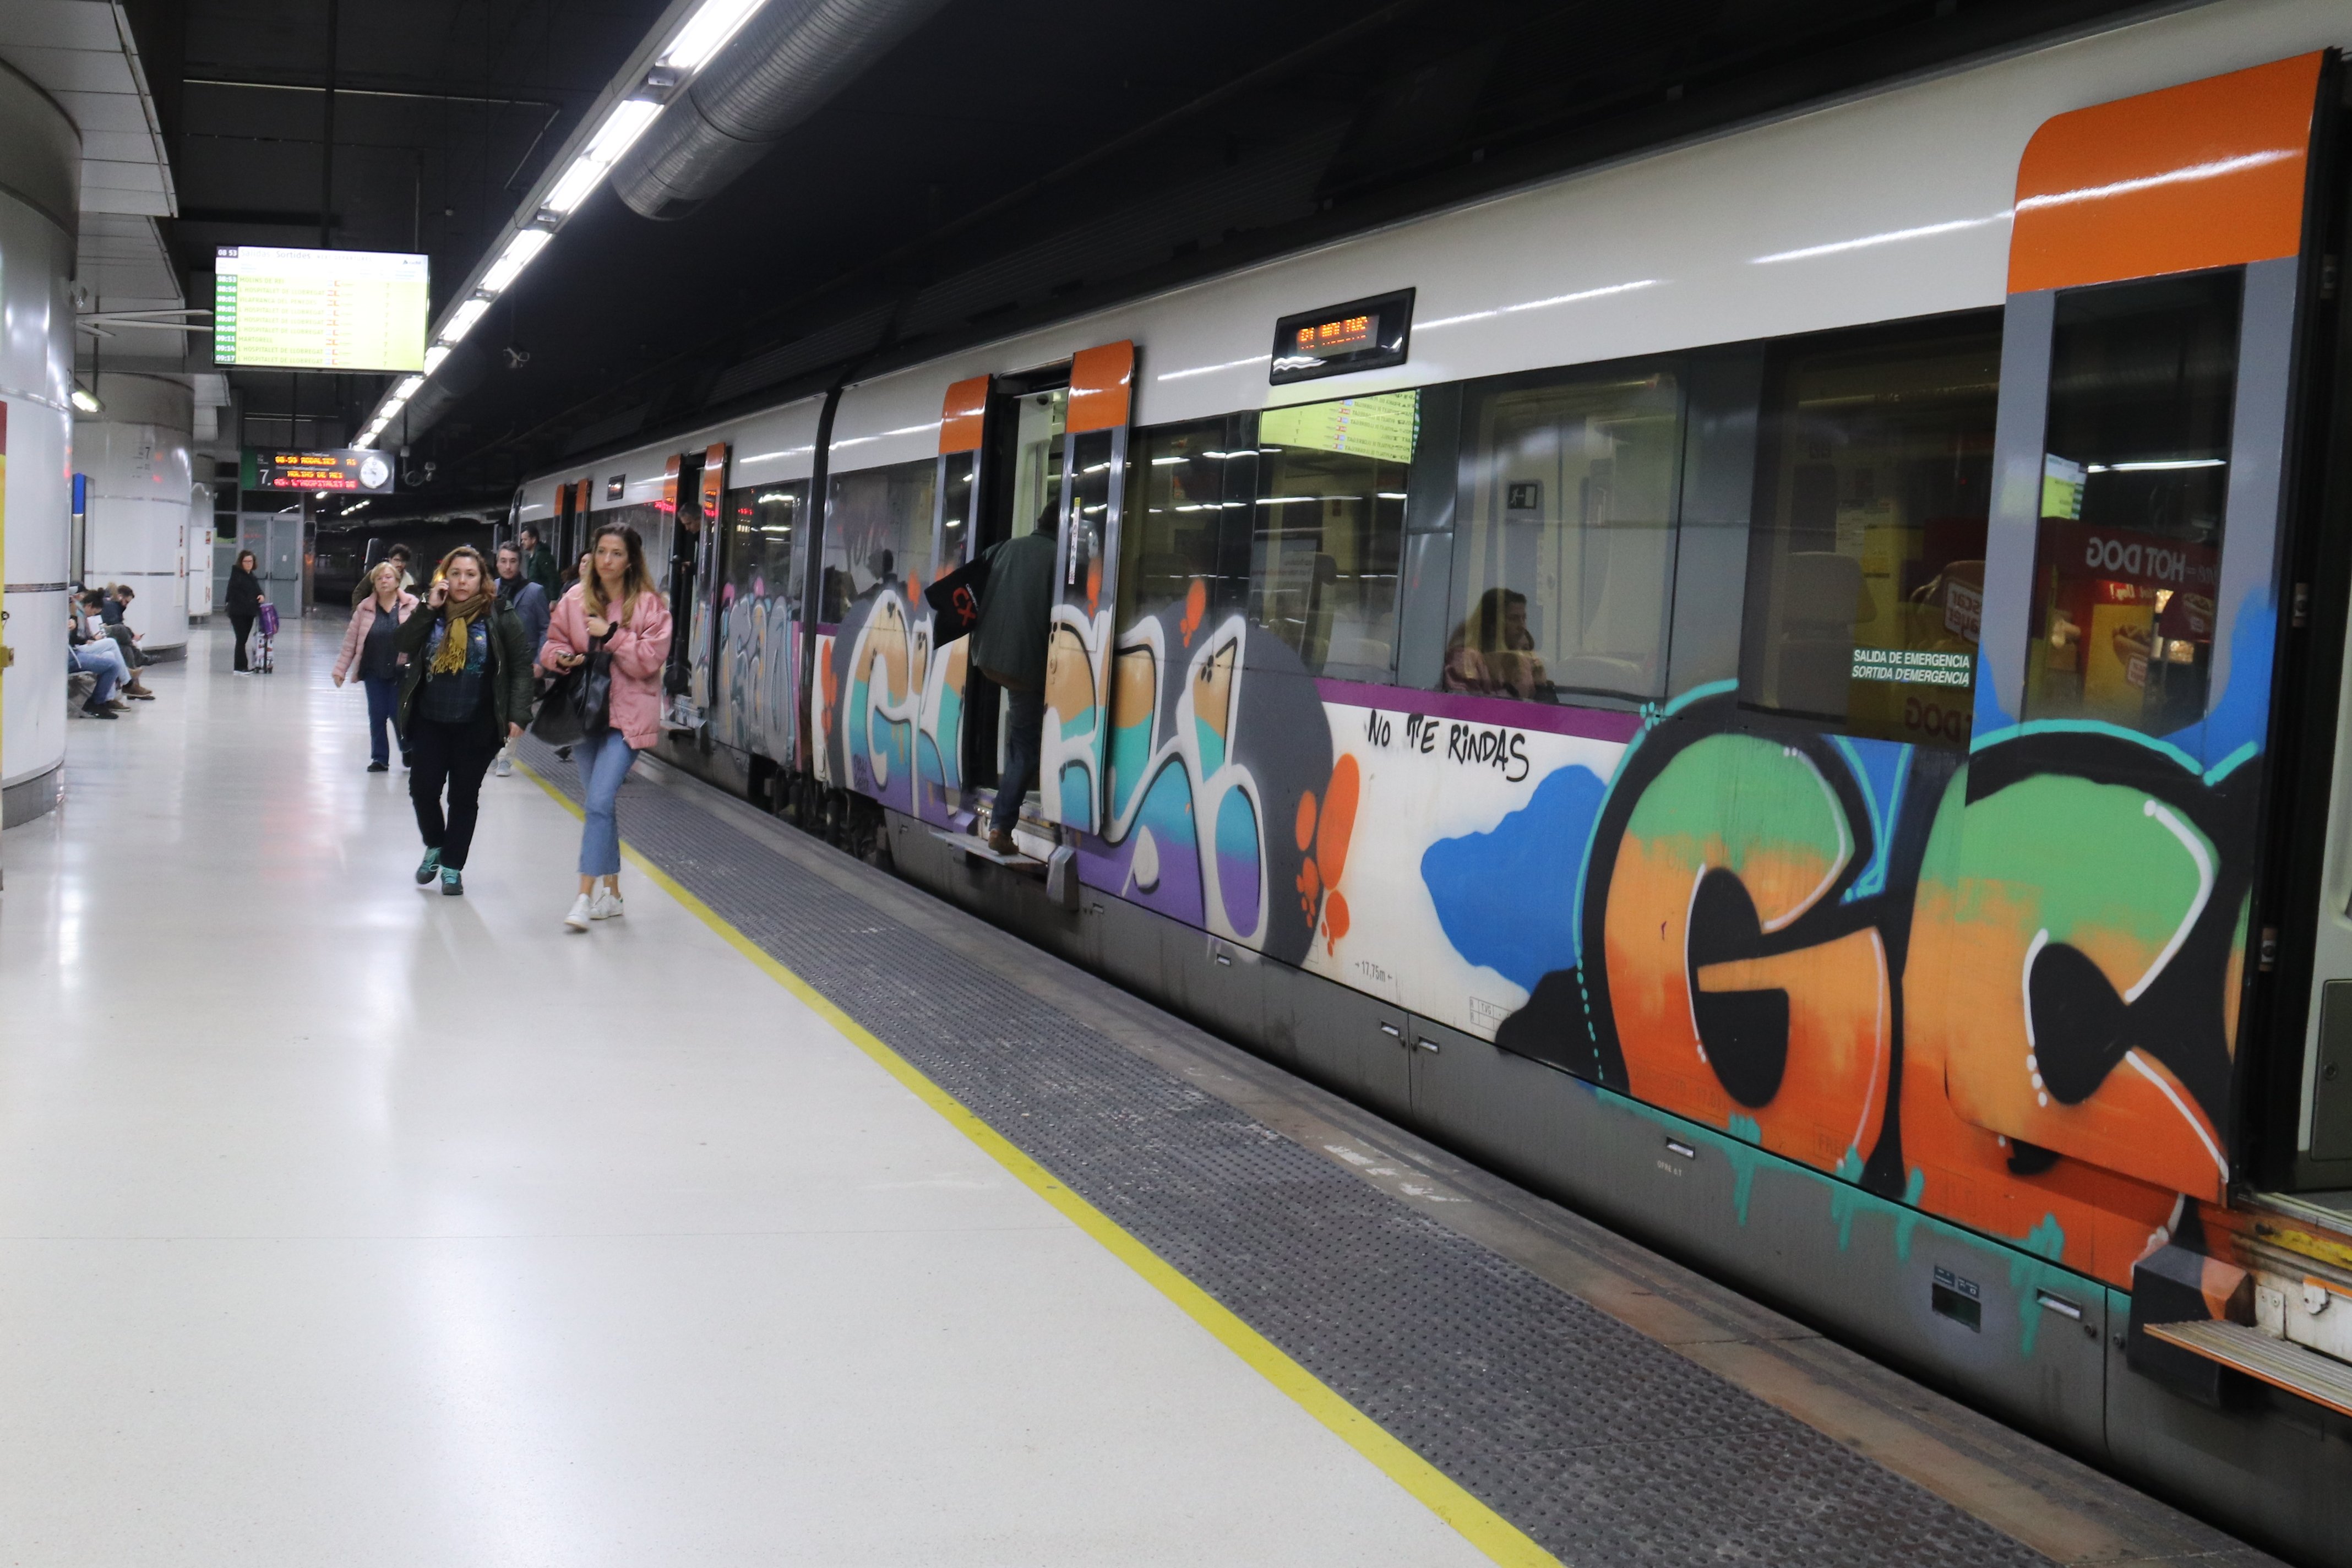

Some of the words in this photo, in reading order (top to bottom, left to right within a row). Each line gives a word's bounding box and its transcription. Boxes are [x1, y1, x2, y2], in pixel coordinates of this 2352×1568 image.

[276, 251, 311, 259] Sortides
[1854, 649, 1887, 663] SALIDA
[1888, 652, 1902, 665] DE
[1904, 652, 1970, 668] EMERGENCIA
[1852, 665, 1893, 680] SORTIDA
[1895, 667, 1970, 685] D'EMERGÈNCIA
[1368, 709, 1391, 747] NO
[1407, 713, 1440, 753] TE
